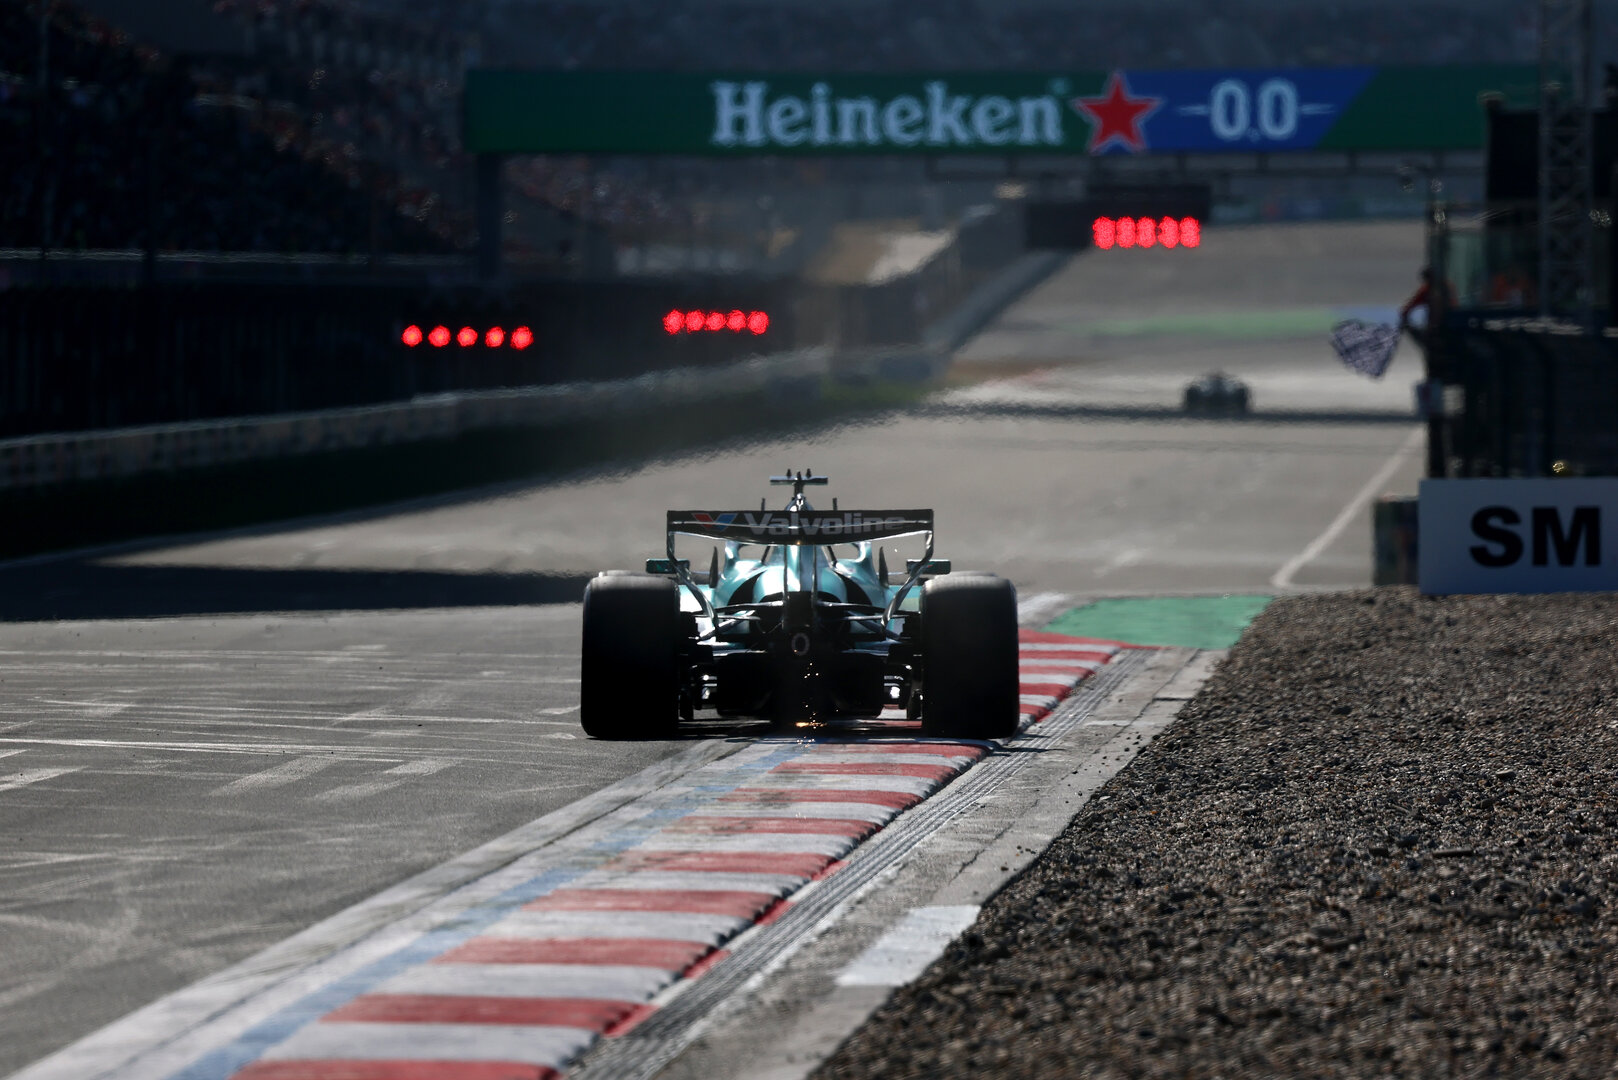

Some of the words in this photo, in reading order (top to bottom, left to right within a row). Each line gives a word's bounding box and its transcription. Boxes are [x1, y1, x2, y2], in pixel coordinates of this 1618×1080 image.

[711, 82, 1063, 145] Heineken
[744, 512, 906, 536] Valvoline
[1469, 506, 1601, 568] SM
